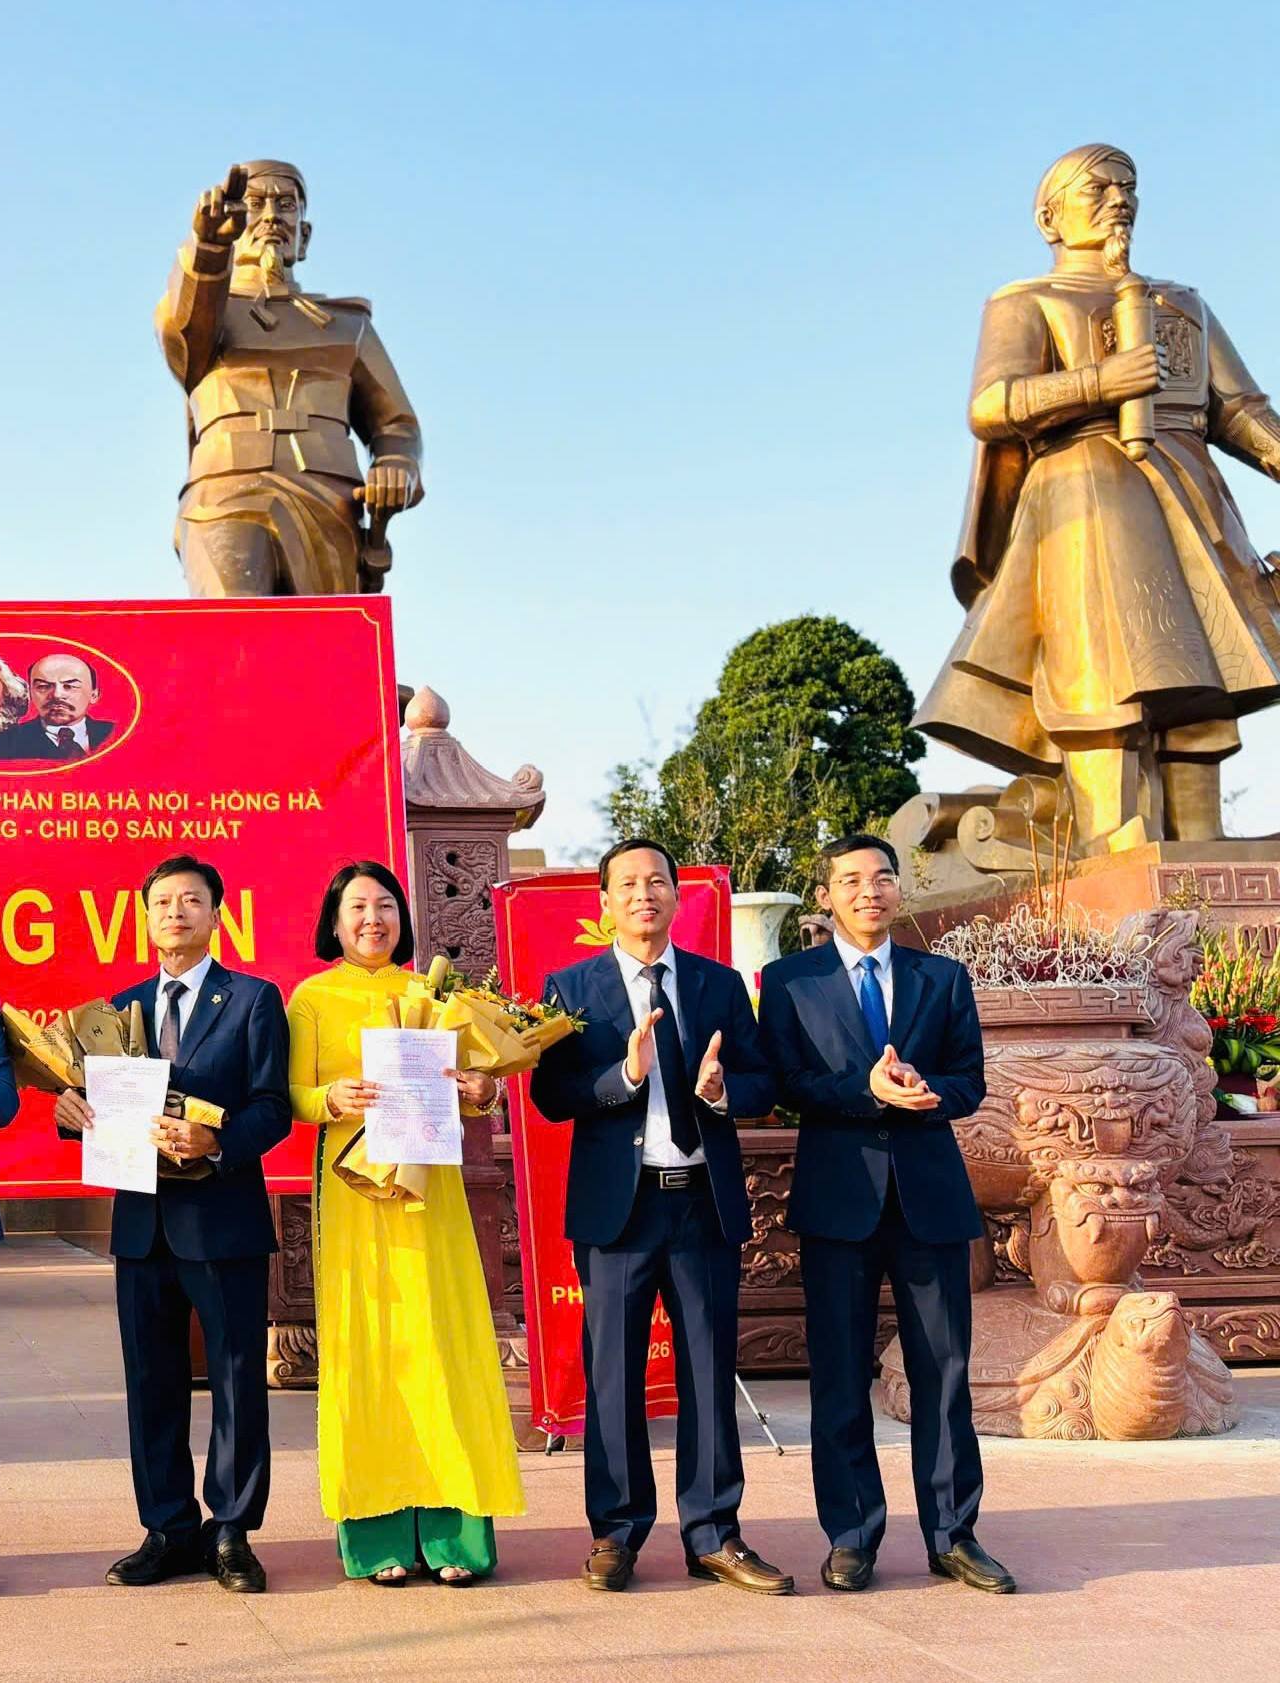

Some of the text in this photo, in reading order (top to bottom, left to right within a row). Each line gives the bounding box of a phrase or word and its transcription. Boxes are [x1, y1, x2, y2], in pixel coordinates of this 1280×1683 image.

[61, 792, 101, 810] BIA
[108, 788, 141, 810] HÀ
[148, 790, 189, 814] NỘI
[288, 788, 322, 810] HÀ
[39, 819, 78, 839] CHI
[85, 819, 119, 843] BỘ
[126, 816, 173, 839] SẢN
[79, 889, 256, 964] VIN
[551, 1286, 584, 1305] PH
